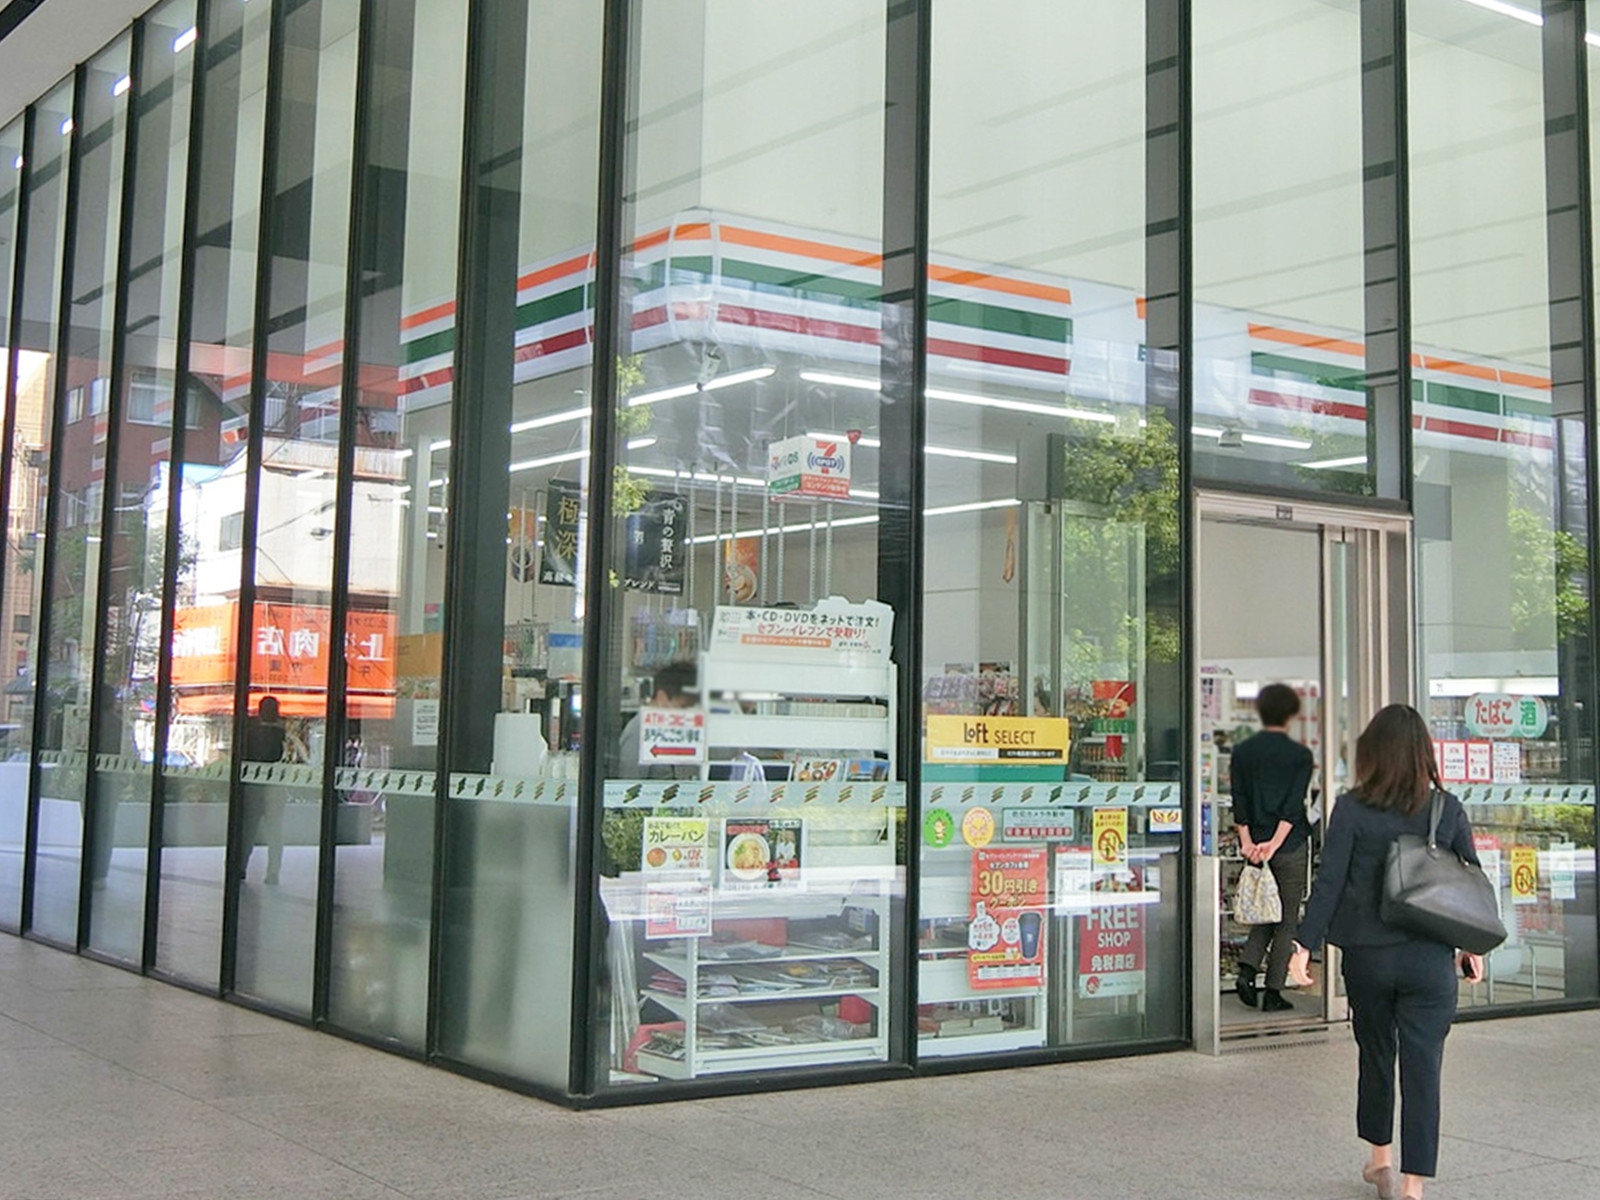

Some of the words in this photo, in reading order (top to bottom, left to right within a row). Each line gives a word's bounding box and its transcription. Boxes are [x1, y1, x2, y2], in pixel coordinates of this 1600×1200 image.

[659, 507, 677, 571] 青の贅沢
[1475, 699, 1513, 725] たばこ
[1520, 701, 1536, 726] 酒
[994, 730, 1036, 745] SELECT
[649, 830, 705, 844] カレーパン
[978, 869, 1039, 896] 30円引き
[1086, 904, 1140, 931] FREE
[1097, 931, 1132, 948] SHOP
